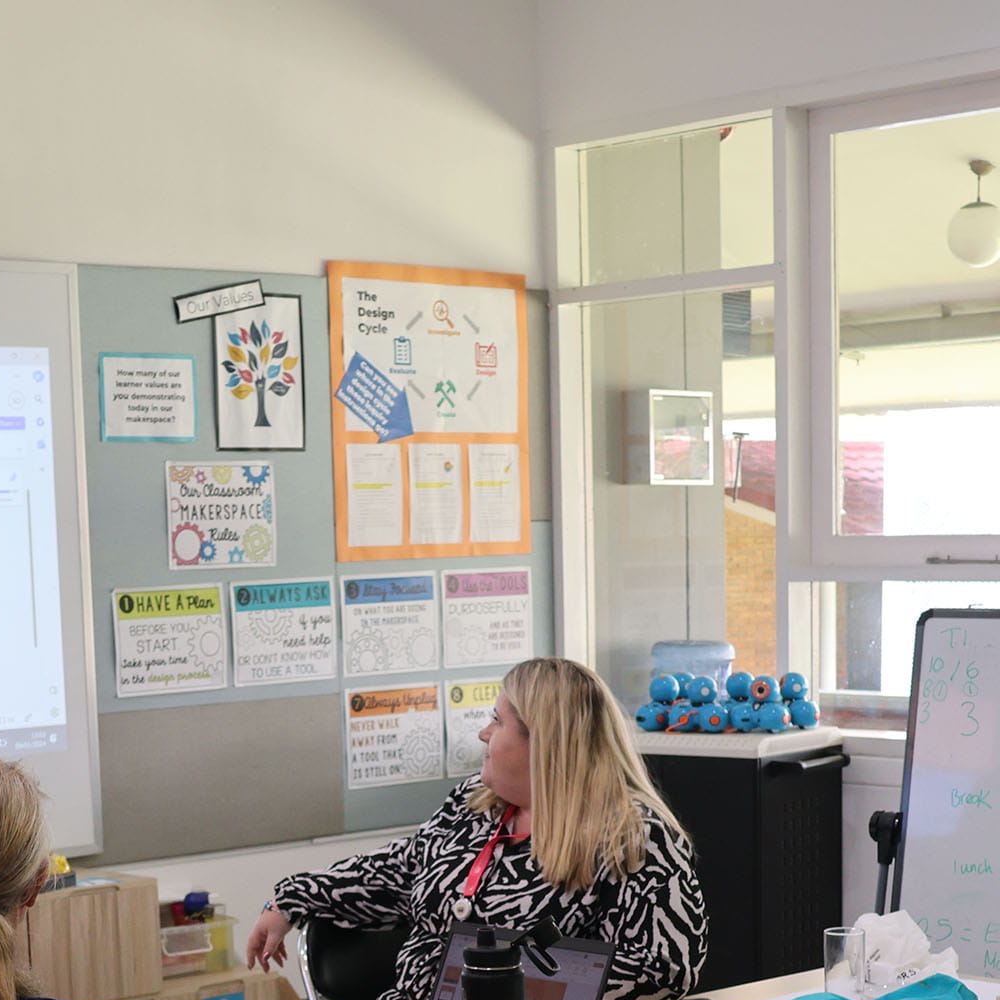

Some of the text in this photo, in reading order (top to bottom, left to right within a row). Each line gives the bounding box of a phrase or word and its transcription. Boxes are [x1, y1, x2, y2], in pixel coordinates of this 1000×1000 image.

[186, 288, 255, 315] Our Values
[357, 291, 377, 302] The
[357, 307, 395, 320] Design
[358, 323, 388, 336] Cycle
[427, 329, 461, 337] Investigate
[117, 370, 134, 378] How
[136, 371, 157, 380] many
[158, 369, 168, 379] of
[476, 369, 497, 377] Design
[115, 380, 142, 389] learner
[144, 380, 169, 389] values
[113, 392, 186, 403] you demonstrating
[128, 404, 150, 414] today
[151, 404, 159, 412] in
[126, 415, 176, 424] makerspace?
[180, 483, 263, 498] Our Classroom
[180, 504, 262, 521] MAKERSPACE
[209, 528, 240, 542] Rules
[494, 575, 528, 591] TOOLS
[252, 587, 301, 604] ALWAYS
[305, 586, 328, 600] ASK
[137, 594, 171, 613] HAVE
[176, 594, 186, 609] A
[187, 595, 215, 610] Plan
[448, 600, 528, 616] PURPOSEFULLY
[299, 613, 332, 629] if you
[129, 622, 190, 636] BEFORE YOU
[137, 637, 177, 654] START
[283, 635, 332, 649] need help
[121, 655, 188, 671] Take your time
[238, 655, 251, 666] OR
[281, 652, 307, 663] KNOW
[309, 650, 330, 661] HOW
[251, 664, 317, 678] TO USE A TOOL
[120, 671, 211, 687] in the design process
[365, 696, 400, 713] Always
[351, 718, 399, 732] NEVER WALK
[960, 700, 981, 737] 3
[352, 734, 397, 748] AWAY FROM
[360, 751, 379, 762] TOOL
[383, 748, 402, 760] THAT
[353, 765, 400, 780] IS STILL ON
[951, 787, 993, 808] Break
[953, 858, 993, 875] lunch
